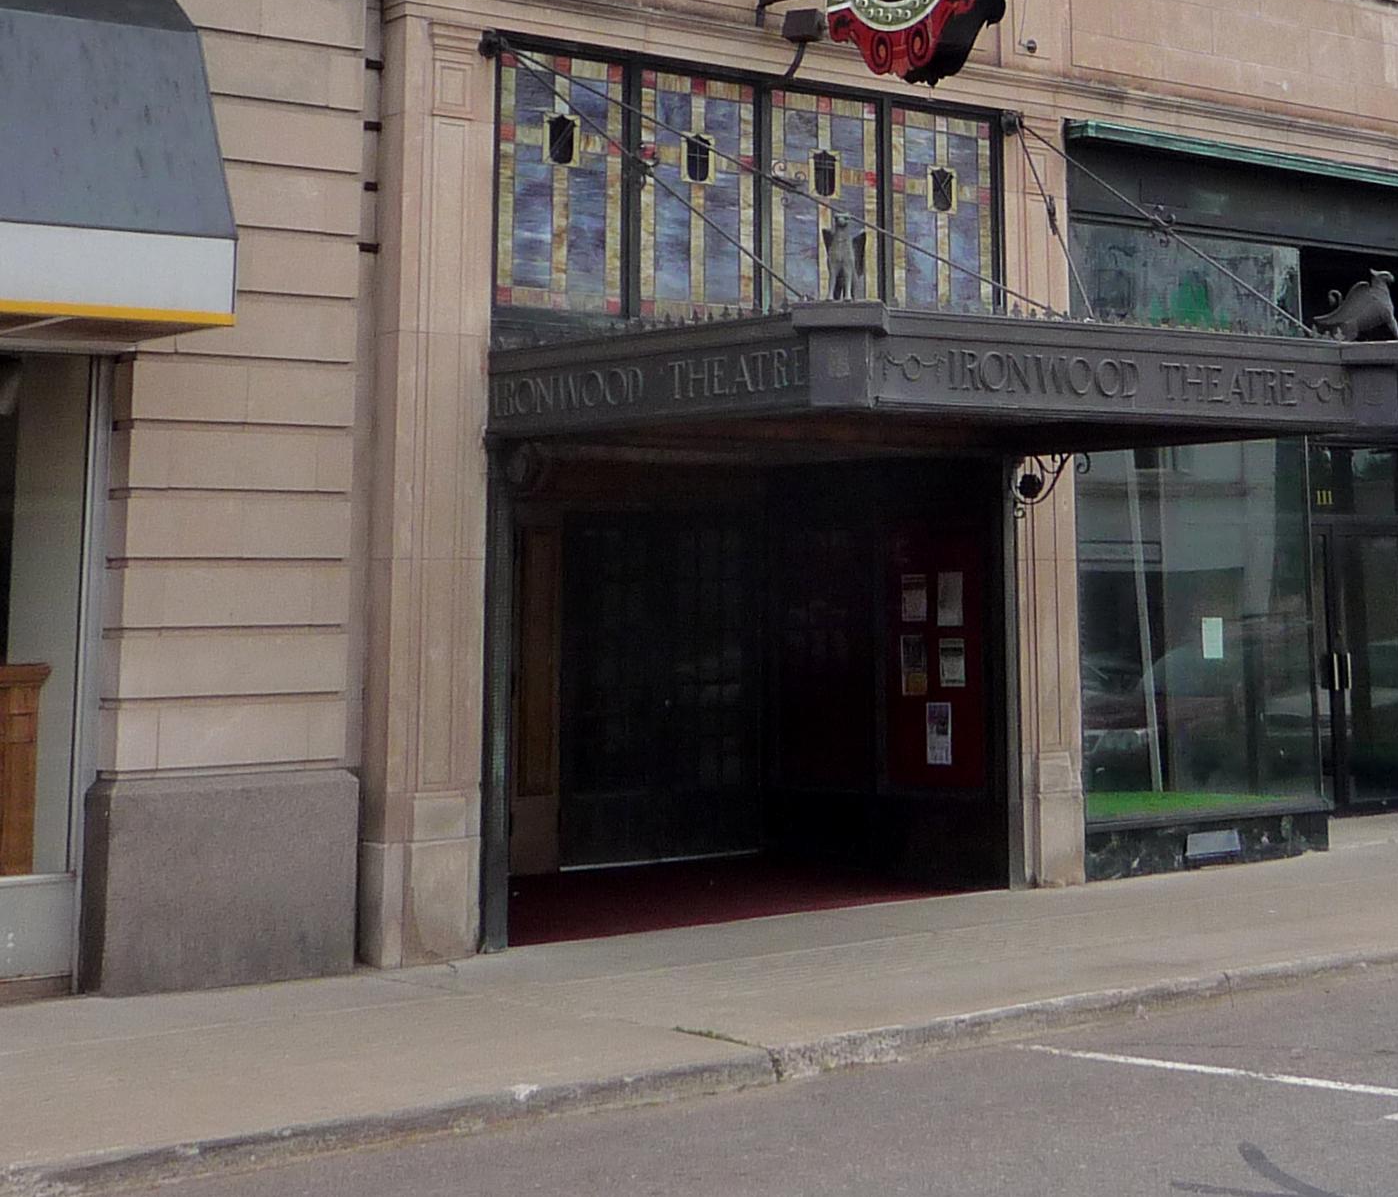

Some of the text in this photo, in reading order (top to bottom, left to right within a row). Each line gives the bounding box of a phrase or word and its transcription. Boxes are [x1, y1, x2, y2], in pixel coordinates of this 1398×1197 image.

[493, 346, 808, 418] IRONWOOD THEATRE
[948, 348, 1298, 406] IRONWOOD THEATRE
